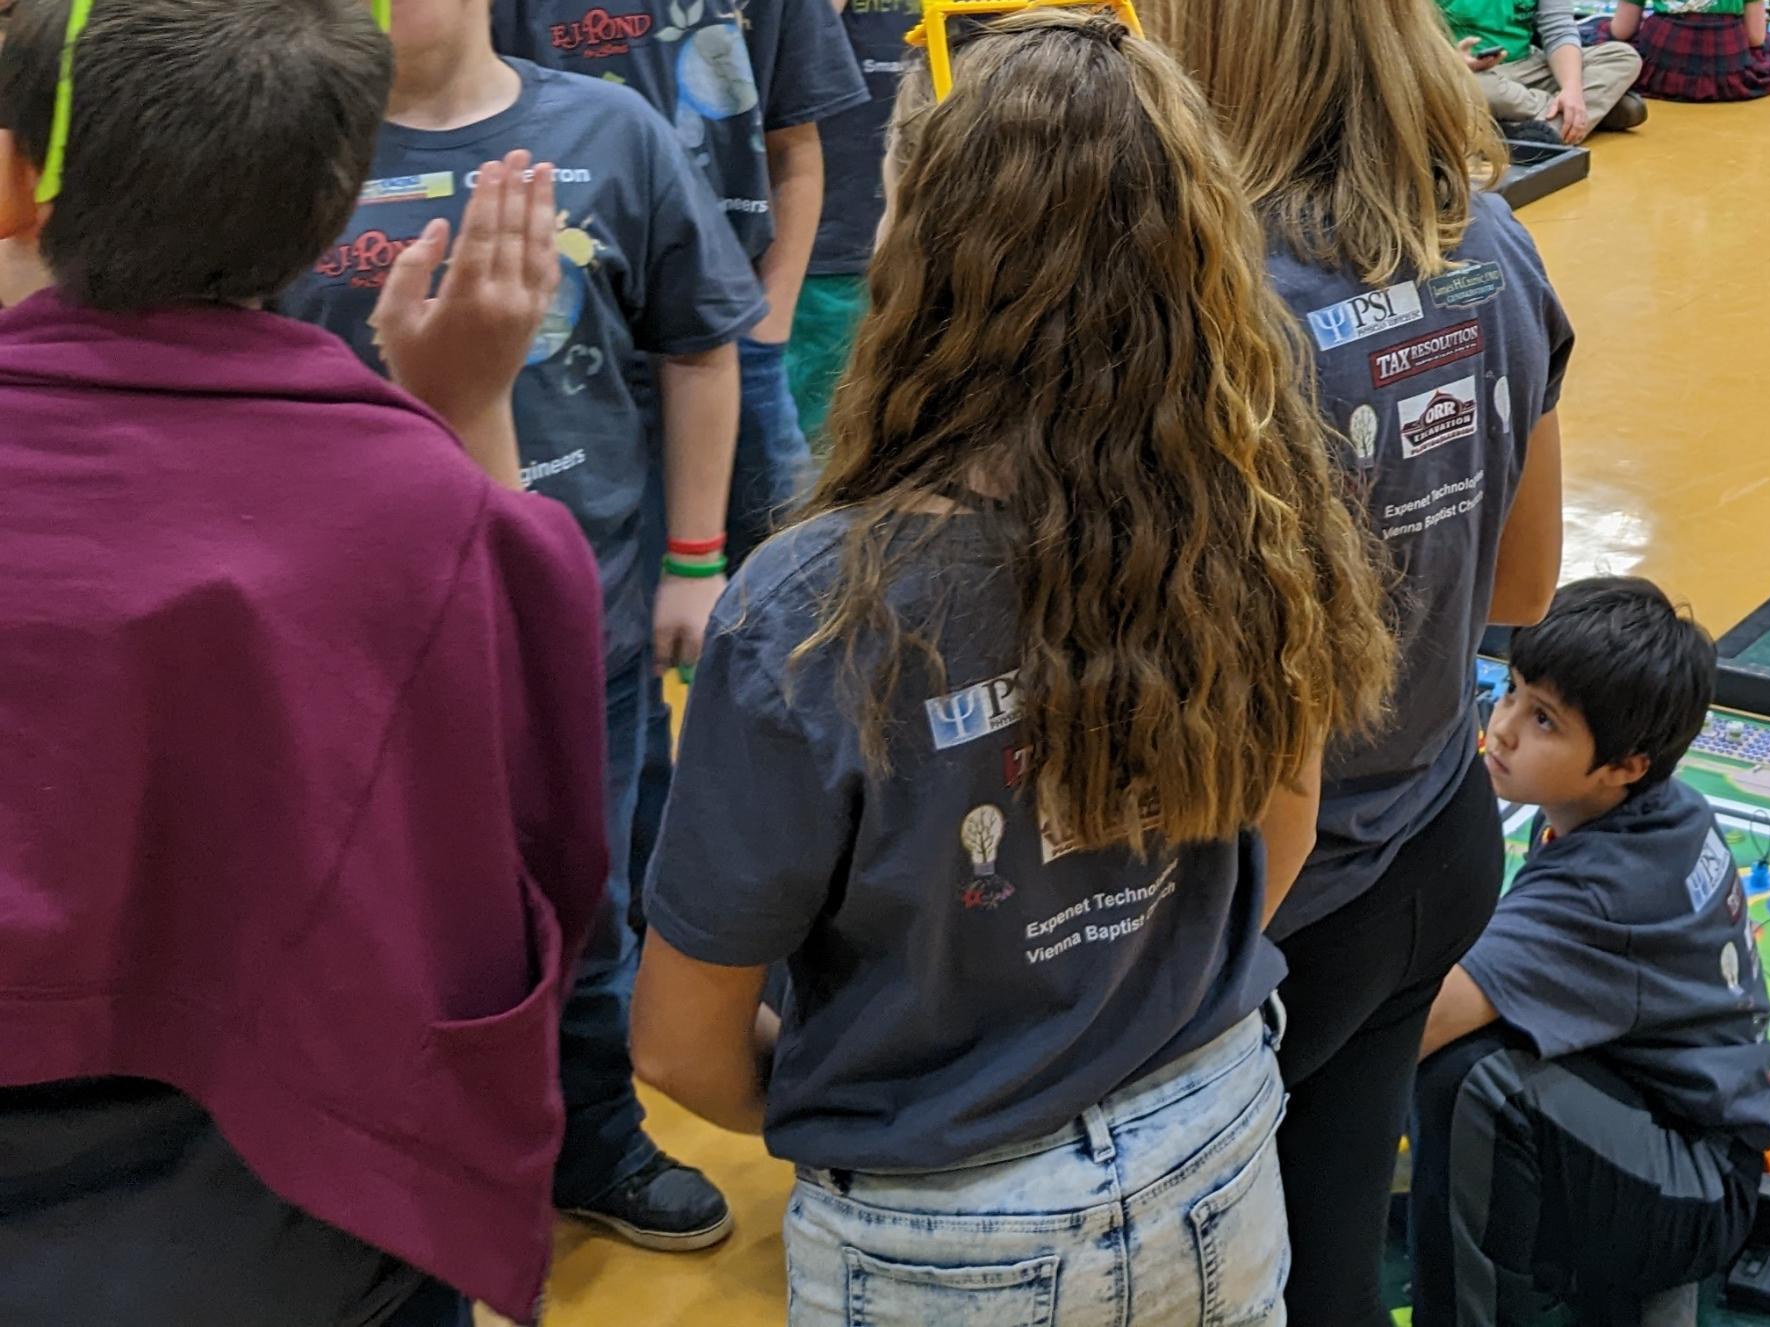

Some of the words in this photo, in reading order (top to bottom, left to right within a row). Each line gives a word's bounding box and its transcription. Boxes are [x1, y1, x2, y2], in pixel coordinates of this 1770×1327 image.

[1347, 288, 1398, 329] PSI
[1376, 347, 1412, 380] TAX
[1410, 325, 1479, 360] RESOLUTION
[1424, 401, 1457, 425] ORR
[1025, 894, 1091, 938] Expenet
[1025, 928, 1081, 966] Vienna
